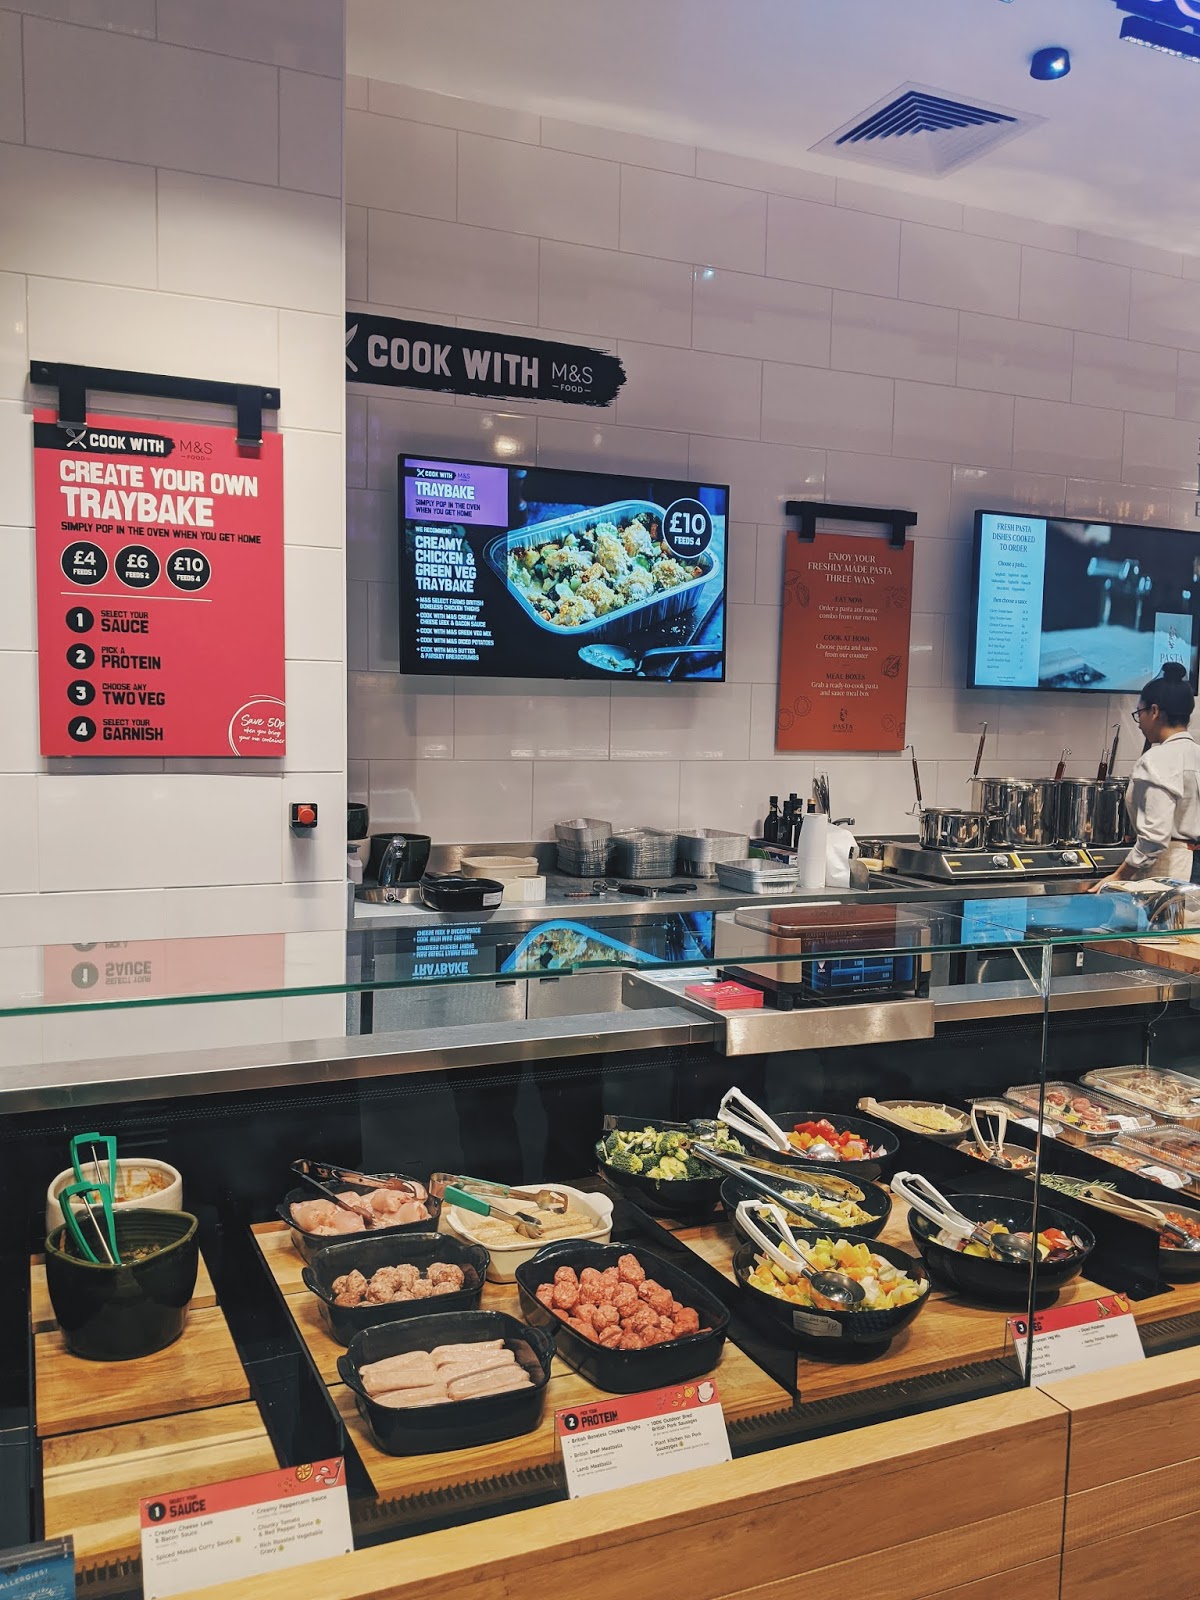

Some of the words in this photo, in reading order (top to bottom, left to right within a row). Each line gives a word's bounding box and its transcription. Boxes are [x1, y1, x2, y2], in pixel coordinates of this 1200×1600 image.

[368, 335, 452, 376] COOK
[462, 348, 539, 388] WITH
[552, 362, 593, 384] M&S
[560, 384, 583, 393] FOOD
[90, 434, 126, 449] COOK
[129, 438, 164, 453] WITH
[180, 440, 213, 454] M&S
[60, 460, 143, 487] CREATE
[150, 467, 204, 492] YOUR
[210, 474, 258, 497] OWN
[415, 481, 475, 500] TRAYBAKE
[60, 486, 214, 527] TRAYBAKE
[669, 512, 706, 534] £10
[997, 523, 1014, 531] FRESH
[1016, 524, 1031, 532] PASTA
[61, 522, 92, 532] SIMPLY
[96, 524, 113, 533] POP
[116, 526, 125, 534] IN
[129, 527, 144, 536] THE
[147, 528, 169, 537] OVEN
[172, 529, 197, 539] WHEN
[200, 532, 216, 541] YOU
[219, 533, 235, 542] GET
[238, 535, 261, 544] HOME
[993, 533, 1011, 541] DISHES
[1013, 535, 1035, 543] COOKED
[415, 536, 462, 551] CREAMY
[674, 536, 694, 545] FEEDS
[1009, 544, 1027, 552] ORDER
[74, 551, 96, 565] £4
[127, 554, 148, 568] £6
[174, 557, 203, 572] £10
[416, 550, 463, 565] CHICKEN
[466, 553, 474, 565] &
[828, 552, 852, 561] ENJOY
[854, 554, 876, 563] YOUR
[416, 564, 452, 578] GREEN
[454, 566, 476, 579] VEG
[808, 562, 843, 572] FRESHLY
[844, 564, 867, 573] MADE
[870, 566, 892, 574] PASTA
[416, 577, 474, 592] TRAYBAKE
[825, 574, 852, 582] THREE
[854, 576, 875, 584] WAYS
[76, 613, 83, 627] 1
[101, 610, 127, 618] SELECT
[101, 619, 149, 633] SAUCE
[76, 650, 86, 663] 2
[101, 655, 161, 669] PROTEIN
[1160, 653, 1184, 663] PASTA
[76, 686, 86, 700] 3
[103, 692, 135, 705] TWO
[138, 693, 165, 706] VEG
[241, 714, 264, 726] Save
[267, 718, 285, 729] 50p
[76, 723, 88, 736] 4
[103, 728, 163, 740] GARNISH
[268, 729, 280, 737] bring
[569, 1418, 575, 1426] 2
[582, 1410, 618, 1427] PROTEIN
[574, 1450, 588, 1458] British
[602, 1443, 623, 1451] Meatballs
[591, 1461, 612, 1469] Meatballs
[155, 1507, 159, 1517] 1
[170, 1499, 206, 1517] SAUCE
[257, 1506, 277, 1514] Creamy
[279, 1499, 309, 1509] Peppercorn
[155, 1527, 176, 1537] Creamy
[179, 1523, 198, 1531] Cheese
[258, 1521, 278, 1530] Chunky
[281, 1517, 300, 1525] Tomato
[277, 1525, 295, 1533] Pepper
[161, 1535, 178, 1543] Bacon
[156, 1552, 175, 1561] Spiced
[199, 1542, 214, 1551] Curry
[217, 1539, 233, 1547] Sauce
